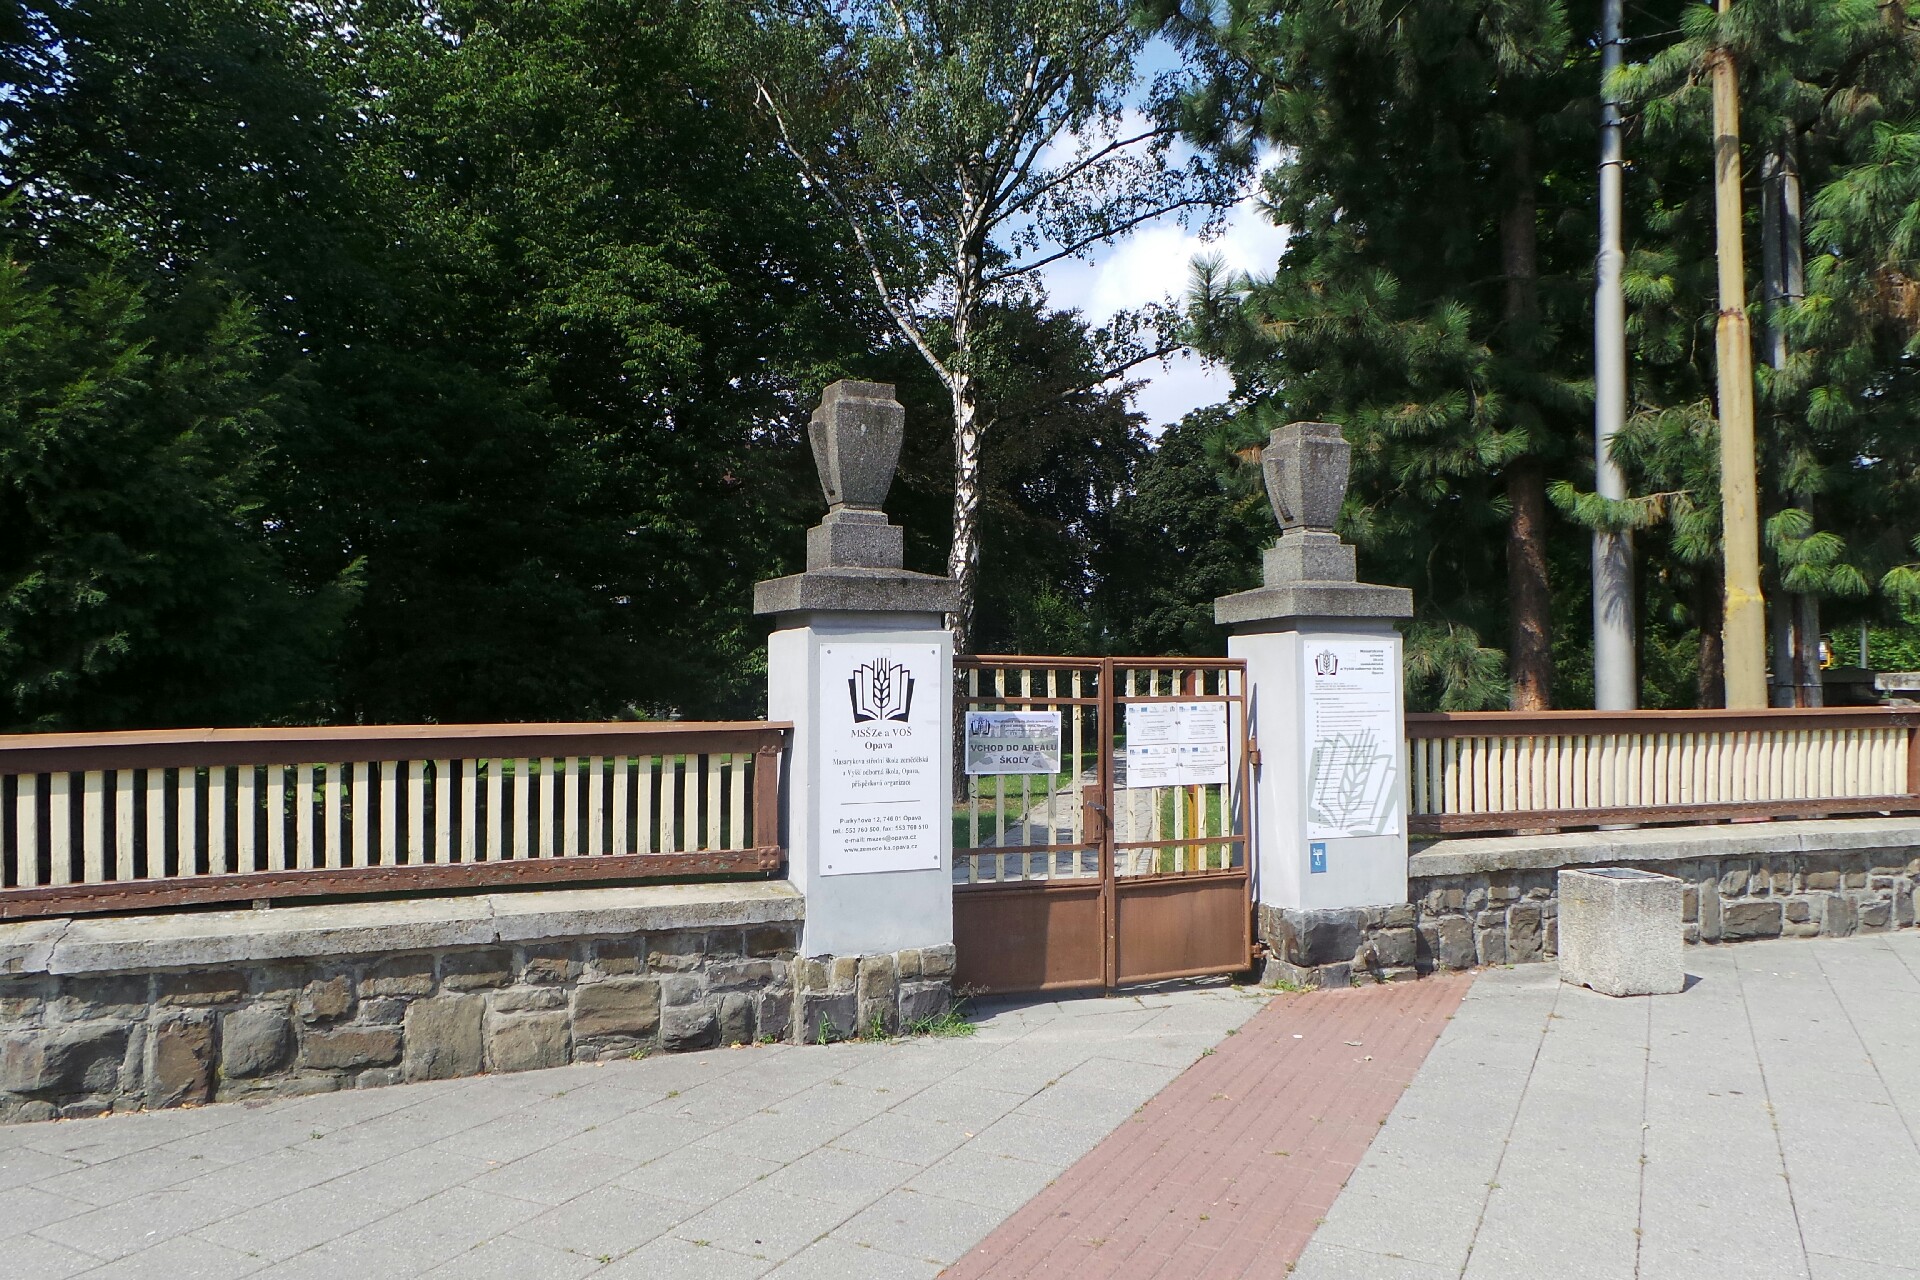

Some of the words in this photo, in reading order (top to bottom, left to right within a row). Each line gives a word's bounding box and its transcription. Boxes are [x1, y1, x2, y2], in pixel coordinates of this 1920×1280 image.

[851, 727, 882, 738] MSŠZe
[892, 726, 912, 737] VOŠ
[864, 741, 893, 751] Opava
[1000, 756, 1030, 764] ŠKOLY
[903, 814, 922, 822] Opava
